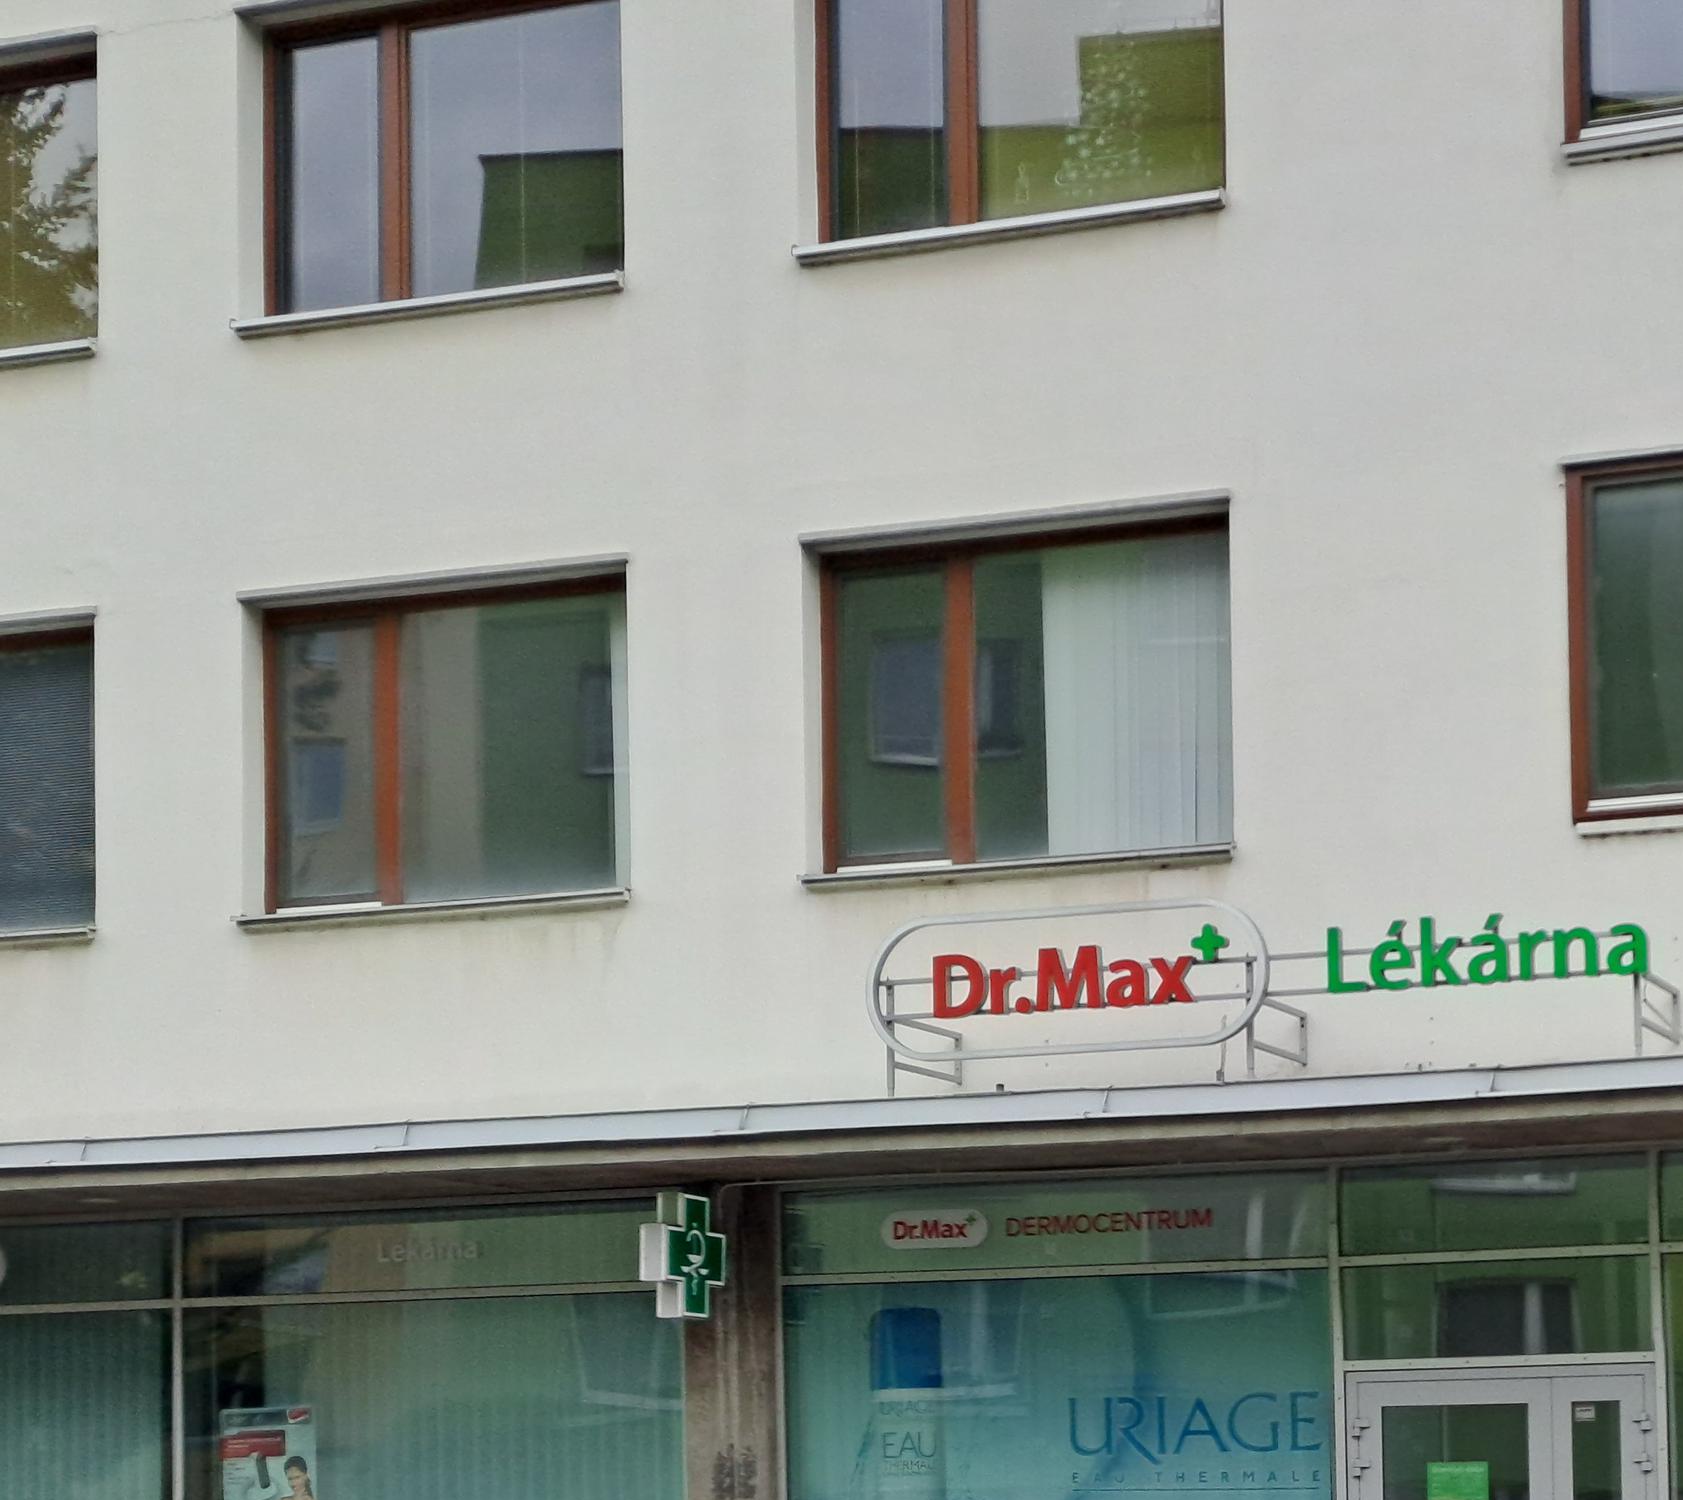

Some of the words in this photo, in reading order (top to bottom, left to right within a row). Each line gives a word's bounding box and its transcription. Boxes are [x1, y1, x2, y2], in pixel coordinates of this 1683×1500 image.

[1326, 913, 1650, 994] Lékárna
[1005, 1208, 1213, 1237] DERMOCENTRUM
[1068, 1391, 1323, 1465] URIAGE
[883, 1431, 937, 1458] EAU
[1072, 1471, 1125, 1484] EAU
[1154, 1470, 1321, 1484] THERMALE
